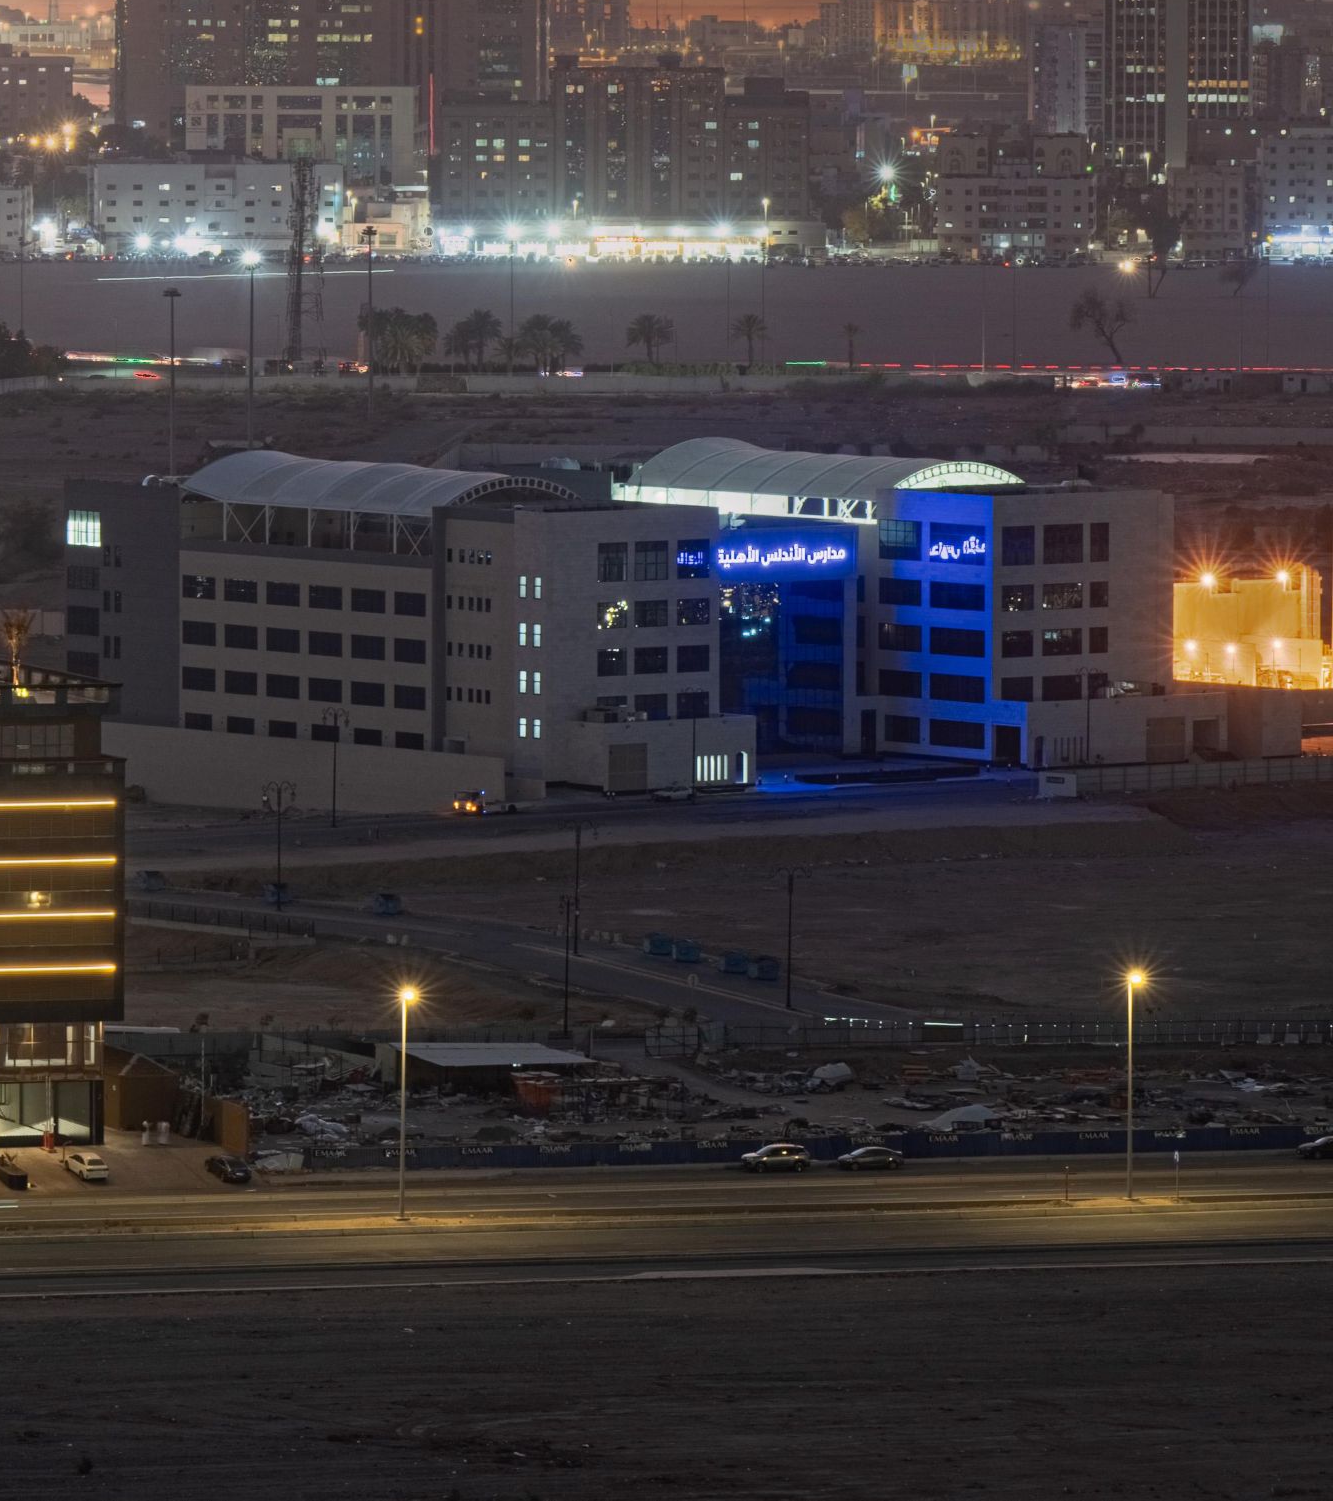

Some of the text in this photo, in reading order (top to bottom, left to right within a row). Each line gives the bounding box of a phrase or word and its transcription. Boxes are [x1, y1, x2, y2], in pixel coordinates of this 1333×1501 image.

[807, 546, 846, 565] مدارس
[928, 1133, 959, 1143] EMAAR
[1078, 1132, 1110, 1141] EMAAR
[385, 1148, 416, 1157] EMAR
[461, 1146, 493, 1156] EMAAR
